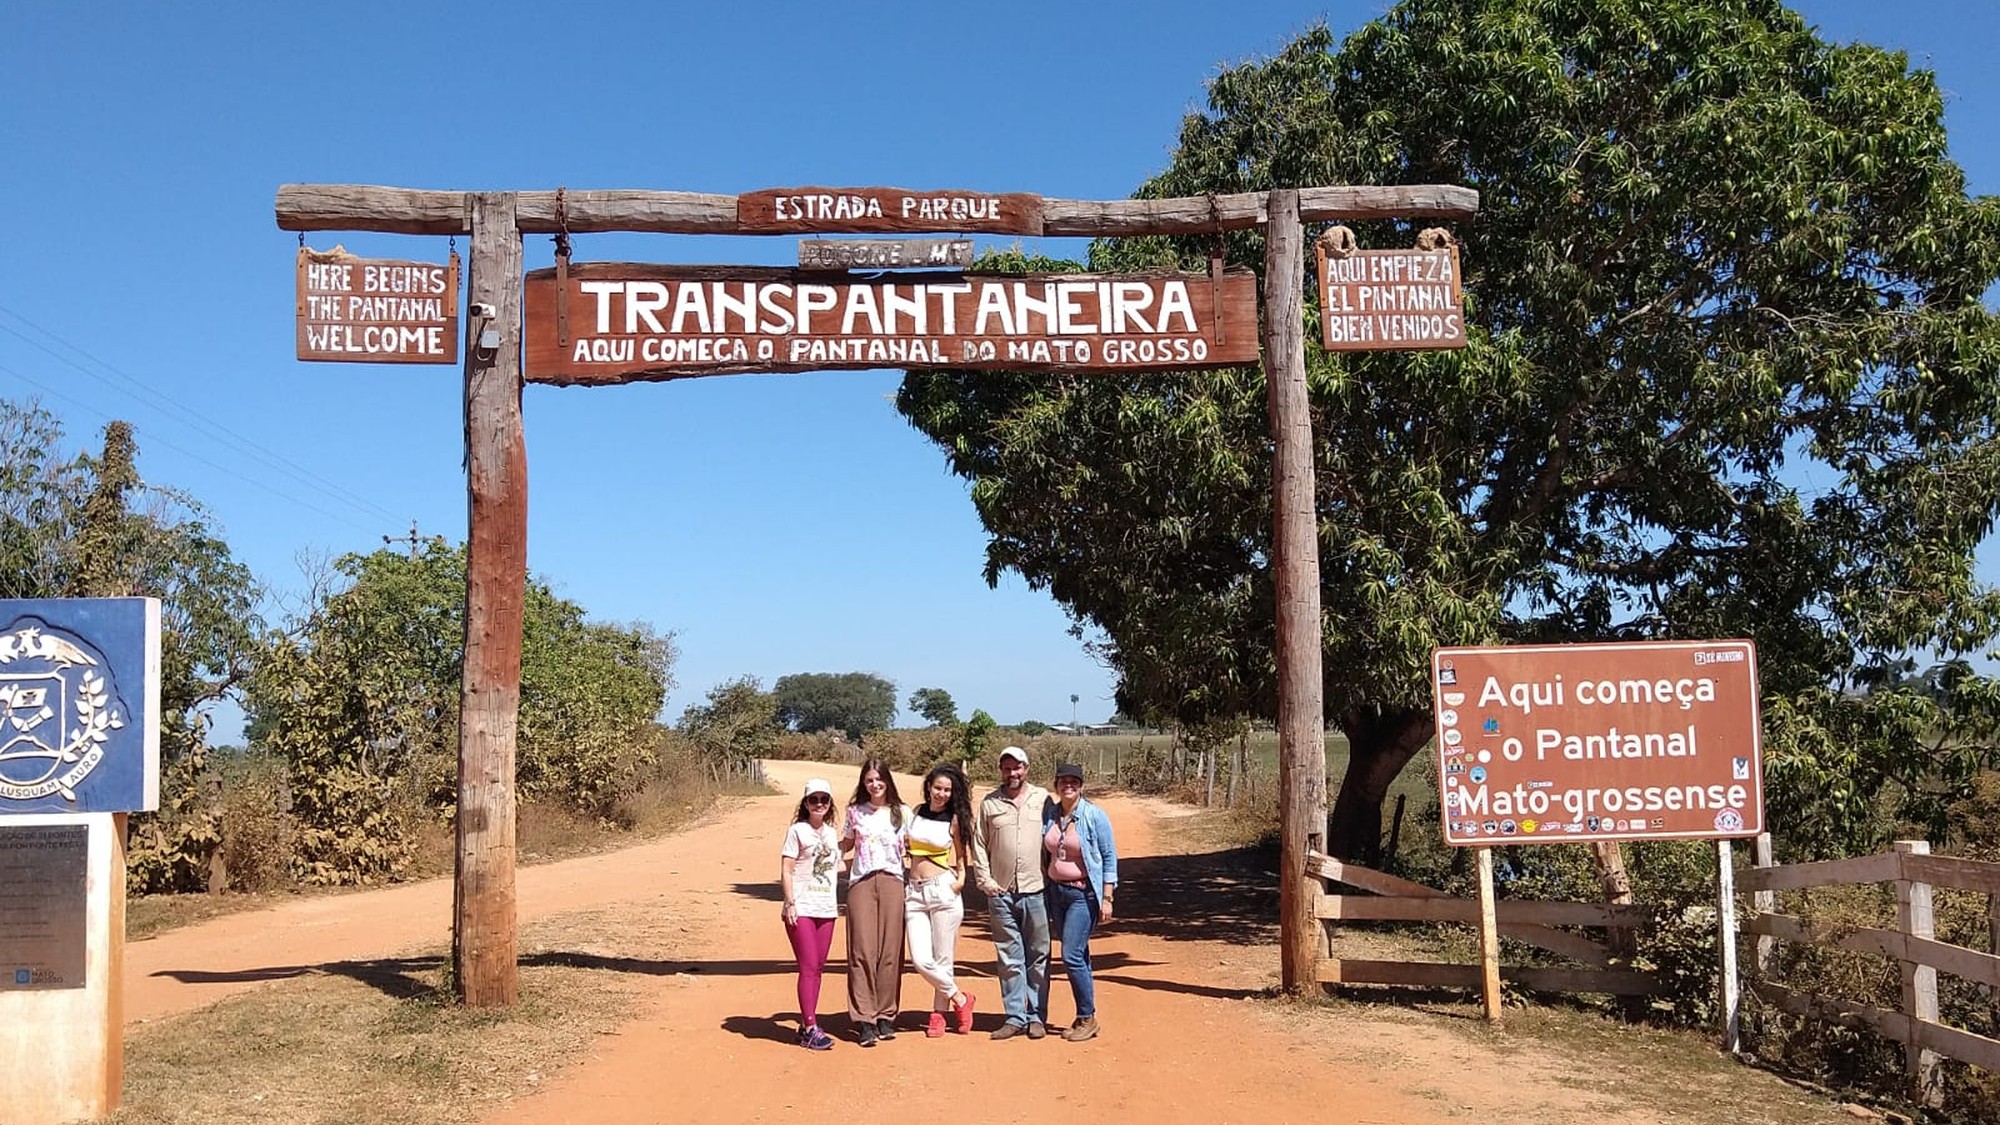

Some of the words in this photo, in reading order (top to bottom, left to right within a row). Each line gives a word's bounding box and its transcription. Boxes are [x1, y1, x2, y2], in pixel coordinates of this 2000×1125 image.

[775, 195, 882, 220] ESTRADA
[903, 197, 1001, 221] PARQUE
[308, 264, 352, 292] HERE
[365, 266, 446, 293] BEGINS
[1327, 256, 1366, 283] AQUI
[1371, 255, 1453, 281] EMPIEZA
[307, 296, 342, 320] THE
[350, 297, 447, 322] PANTANAL
[580, 281, 1199, 335] TRANSPANTANEIRA
[1328, 286, 1354, 311] EL
[1359, 285, 1457, 310] PANTANAL
[307, 325, 445, 354] WELCOME
[1331, 315, 1373, 341] BIEN
[1379, 314, 1459, 341] VENIDOS
[573, 339, 634, 362] AQUI
[758, 339, 774, 361] O
[790, 339, 948, 363] PANTANAL
[964, 340, 995, 361] DO
[1008, 339, 1091, 363] MATO
[1103, 339, 1208, 363] GROSSO
[1478, 674, 1563, 714] Aqui
[1575, 678, 1715, 709] começa
[1502, 737, 1523, 761] o
[1537, 725, 1696, 760] Pantanal
[70, 753, 98, 783] AURO
[1457, 783, 1747, 822] Mato-grossense
